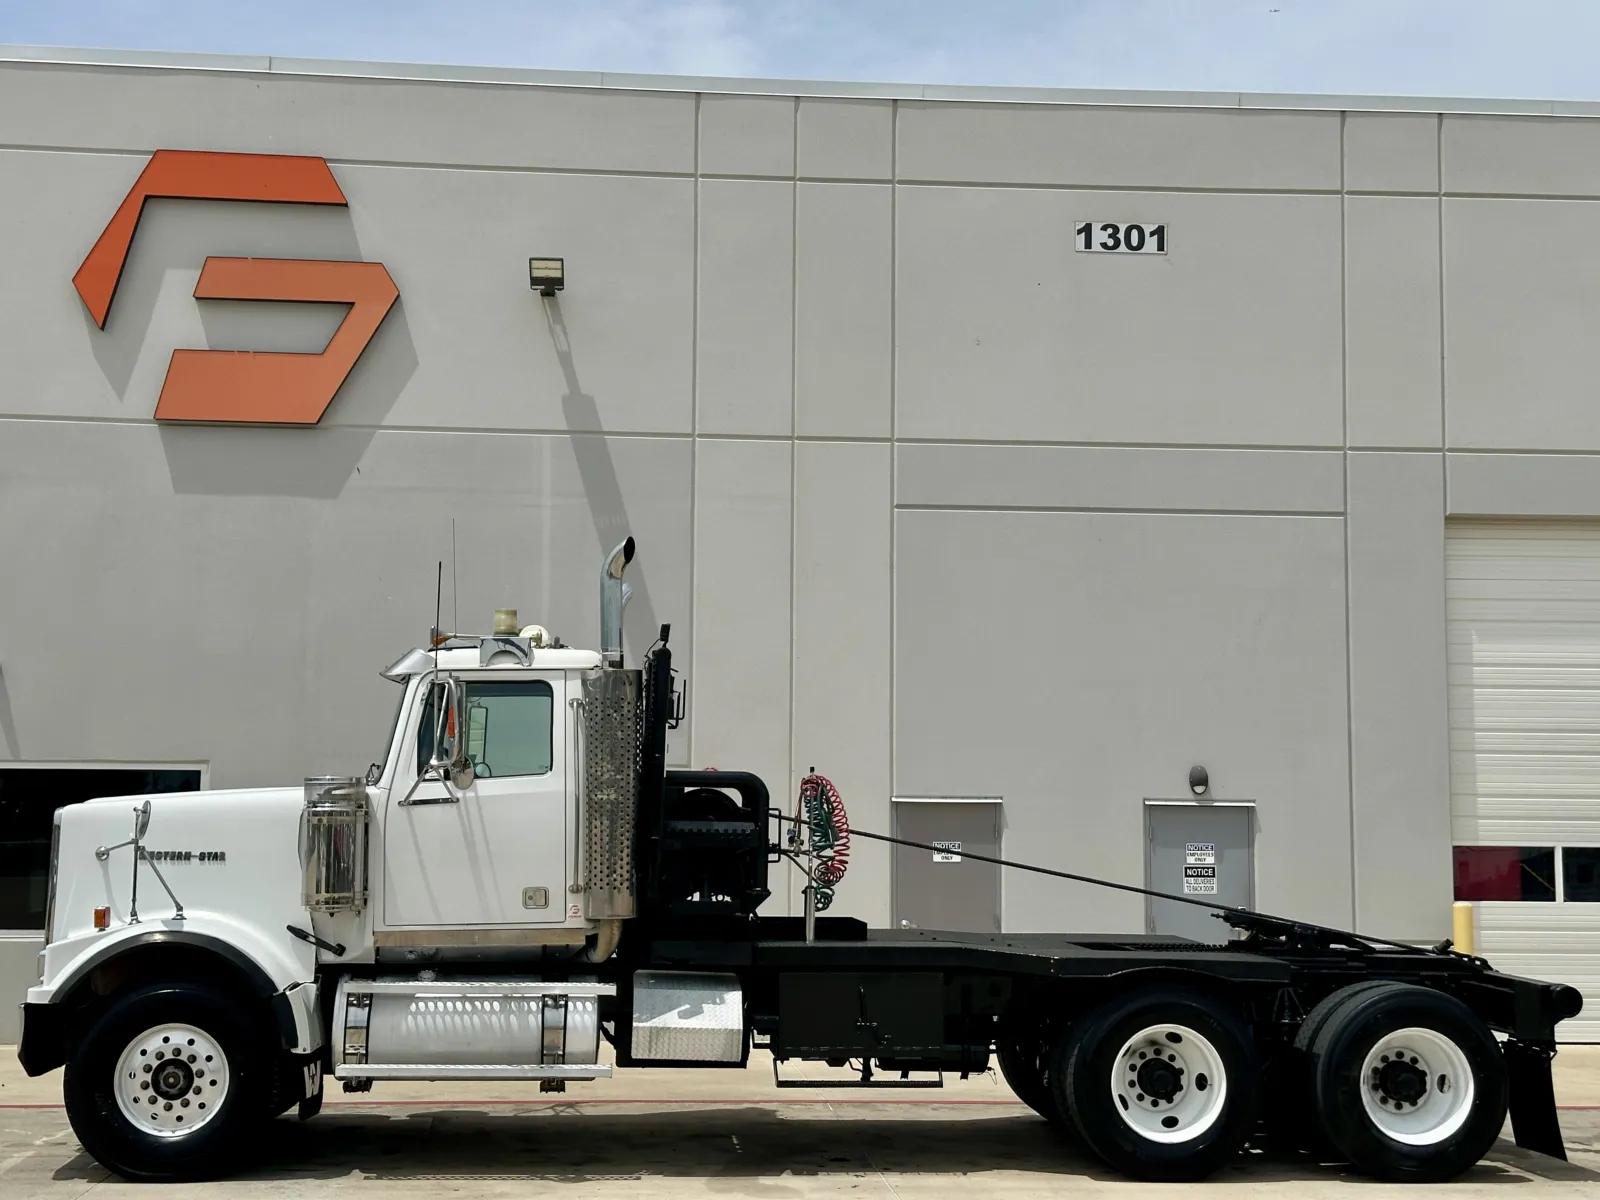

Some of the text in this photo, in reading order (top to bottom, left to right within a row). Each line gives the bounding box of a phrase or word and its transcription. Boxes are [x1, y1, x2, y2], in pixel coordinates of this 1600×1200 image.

[1077, 223, 1165, 252] 1301
[934, 842, 960, 850] NOTICE
[1186, 868, 1214, 876] NOTICE
